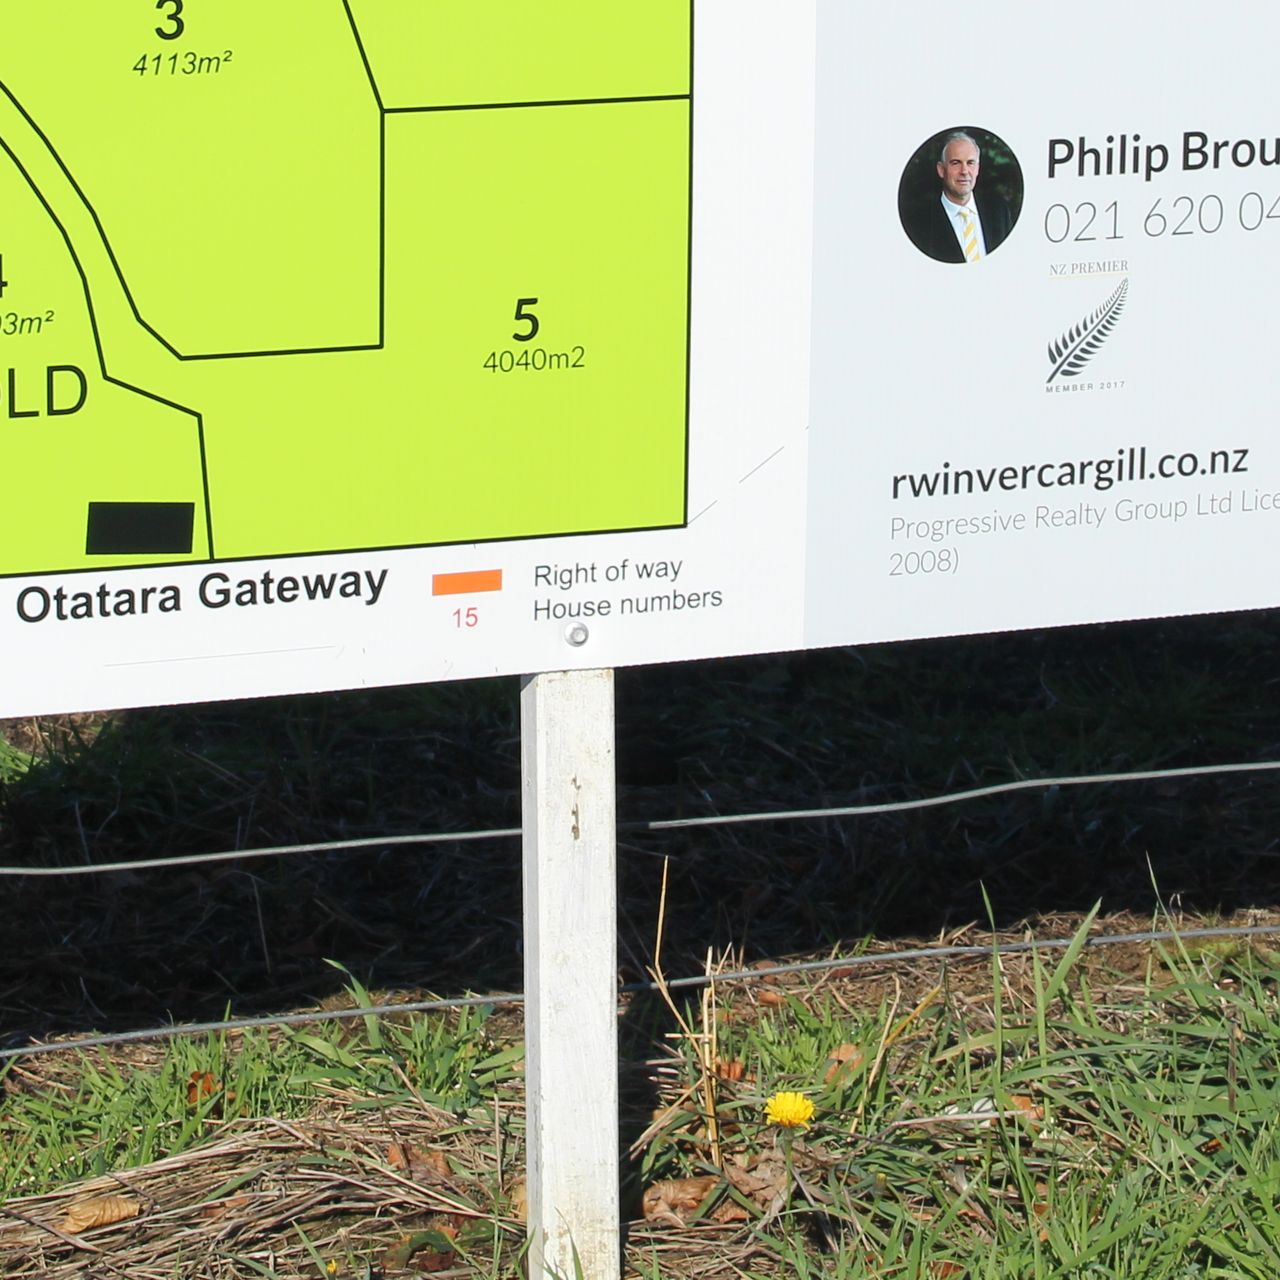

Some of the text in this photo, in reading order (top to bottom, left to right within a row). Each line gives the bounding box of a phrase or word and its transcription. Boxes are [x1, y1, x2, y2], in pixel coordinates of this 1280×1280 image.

[1048, 134, 1168, 182] Philip
[1045, 201, 1123, 243] 021
[1144, 195, 1223, 237] 620
[1051, 260, 1128, 275] NZ PREMIER
[513, 298, 539, 342] 5
[483, 346, 584, 373] 4040m2
[1045, 380, 1126, 393] MEMBER 2017
[892, 447, 1248, 498] rwinvercargill.co.nz
[891, 510, 1025, 542] Progressive
[1036, 503, 1106, 528] Realty
[1115, 499, 1187, 522] Group
[1197, 491, 1231, 515] Ltd
[535, 559, 682, 590] Right of way
[889, 548, 958, 576] 2008)
[17, 566, 387, 623] Otatara Gateway
[533, 588, 723, 621] House numbers
[453, 607, 478, 628] 15
